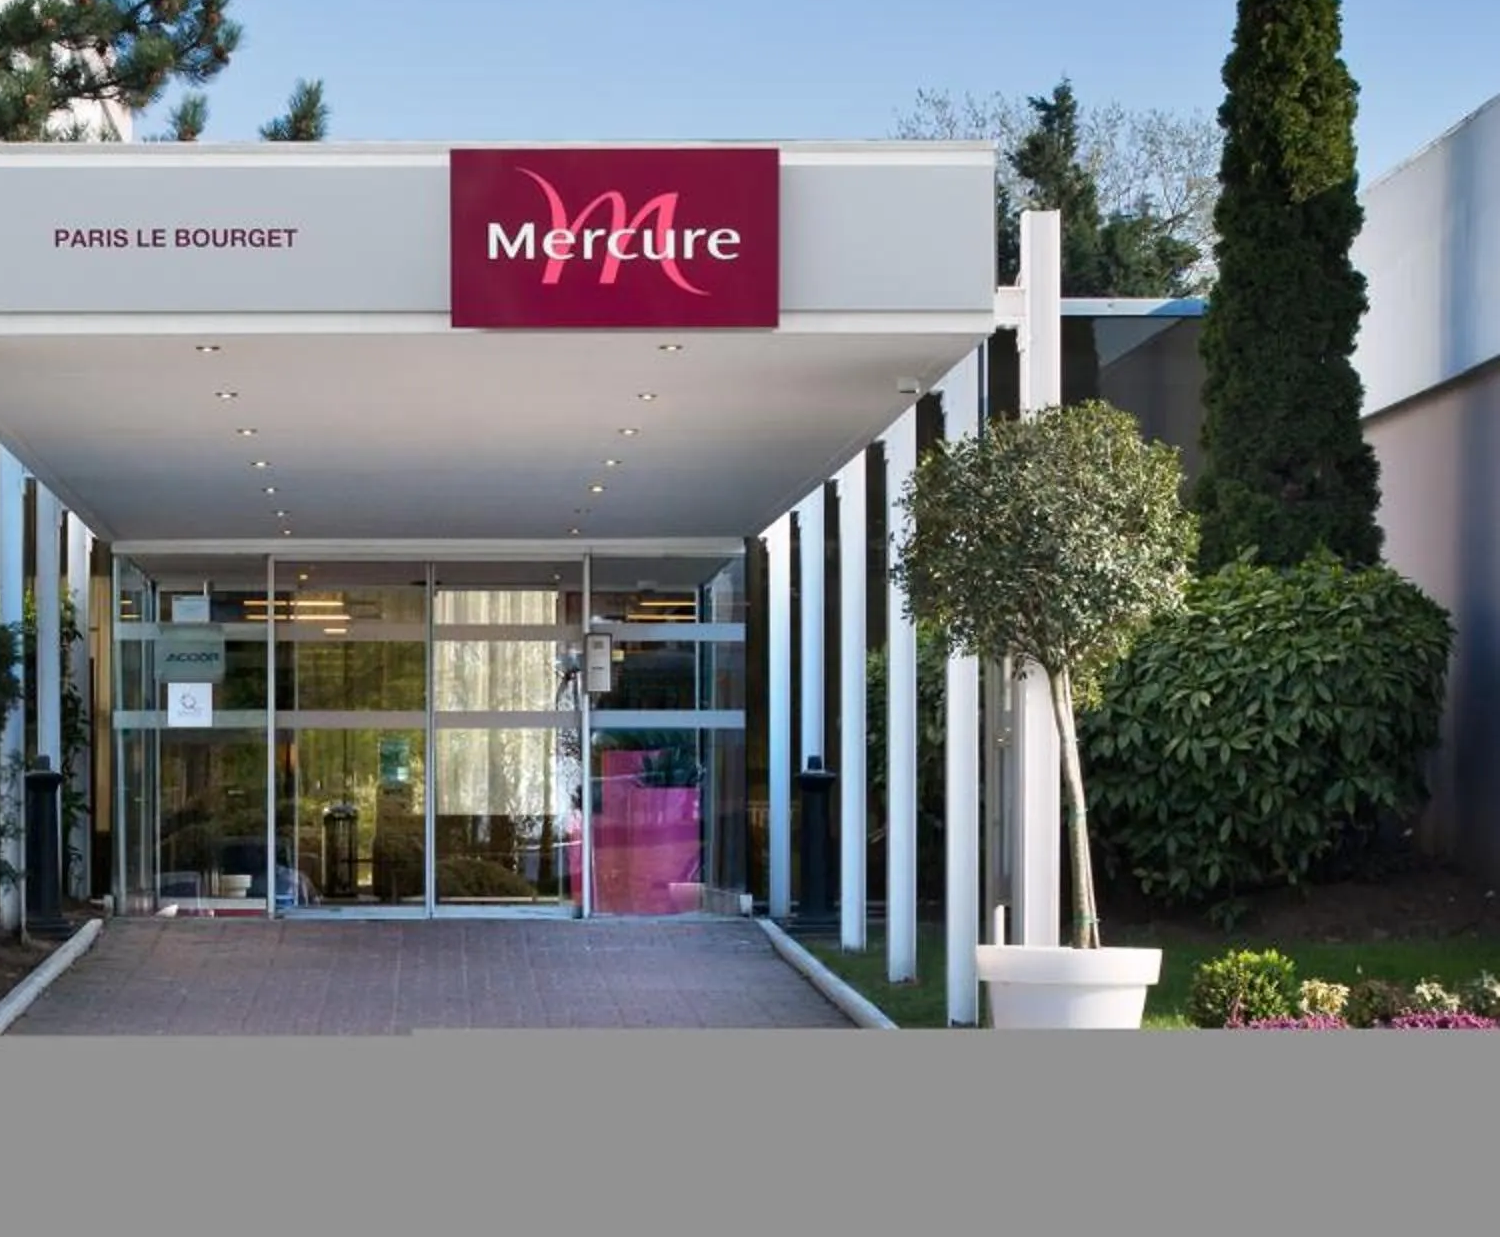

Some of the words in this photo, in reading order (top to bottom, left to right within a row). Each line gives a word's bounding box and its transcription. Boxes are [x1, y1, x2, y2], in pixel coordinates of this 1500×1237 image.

[54, 228, 129, 248] PARIS
[136, 228, 167, 248] LE
[174, 228, 298, 248] BOURGET
[487, 221, 742, 261] Mercure
